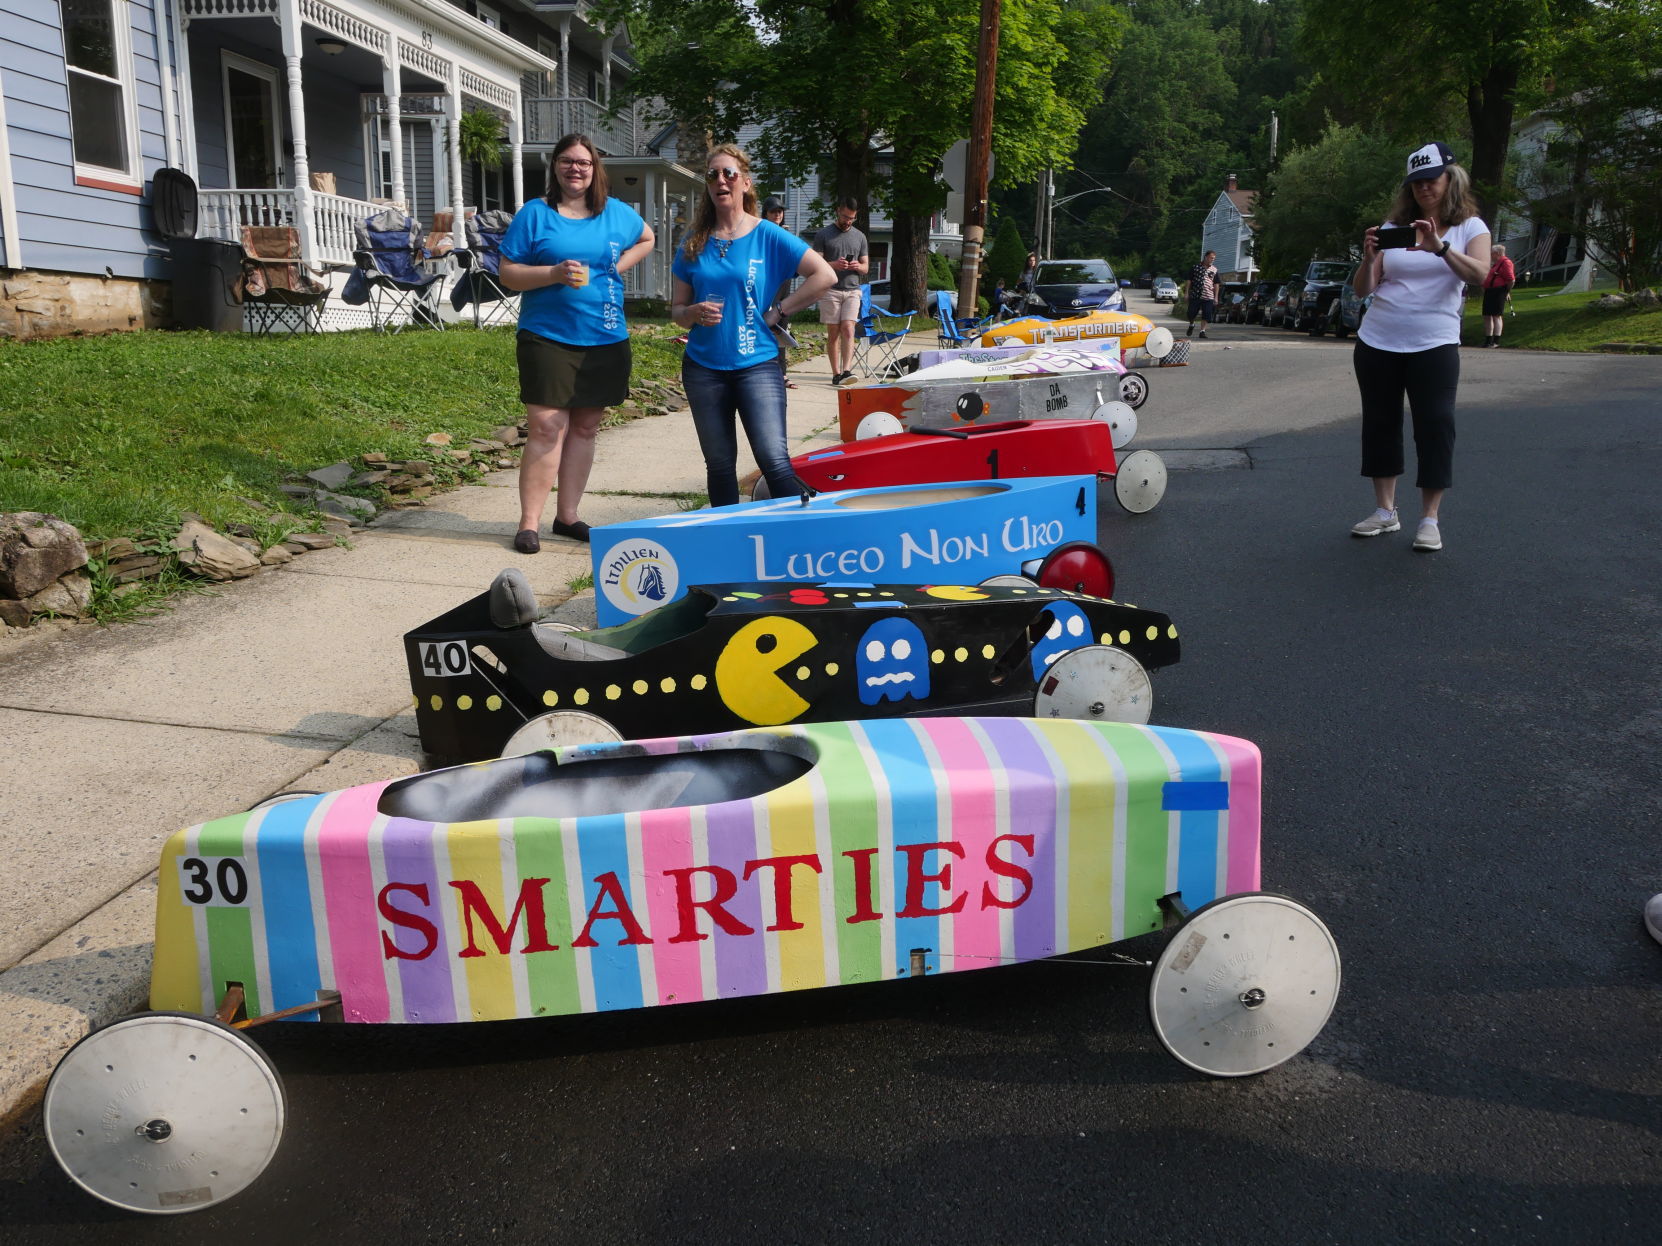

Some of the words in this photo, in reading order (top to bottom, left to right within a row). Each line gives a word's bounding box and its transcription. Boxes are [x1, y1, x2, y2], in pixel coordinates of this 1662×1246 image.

[421, 30, 432, 50] 83
[1410, 154, 1432, 169] Pitt
[603, 303, 611, 329] 2019
[738, 325, 747, 355] 2019
[846, 391, 851, 405] 9
[1046, 395, 1068, 412] BOMB
[1049, 382, 1060, 397] DA
[987, 449, 998, 480] 1
[1075, 486, 1086, 516] 4
[424, 642, 467, 675] 40
[183, 857, 248, 905] 30
[377, 833, 1036, 960] SMARTIES
